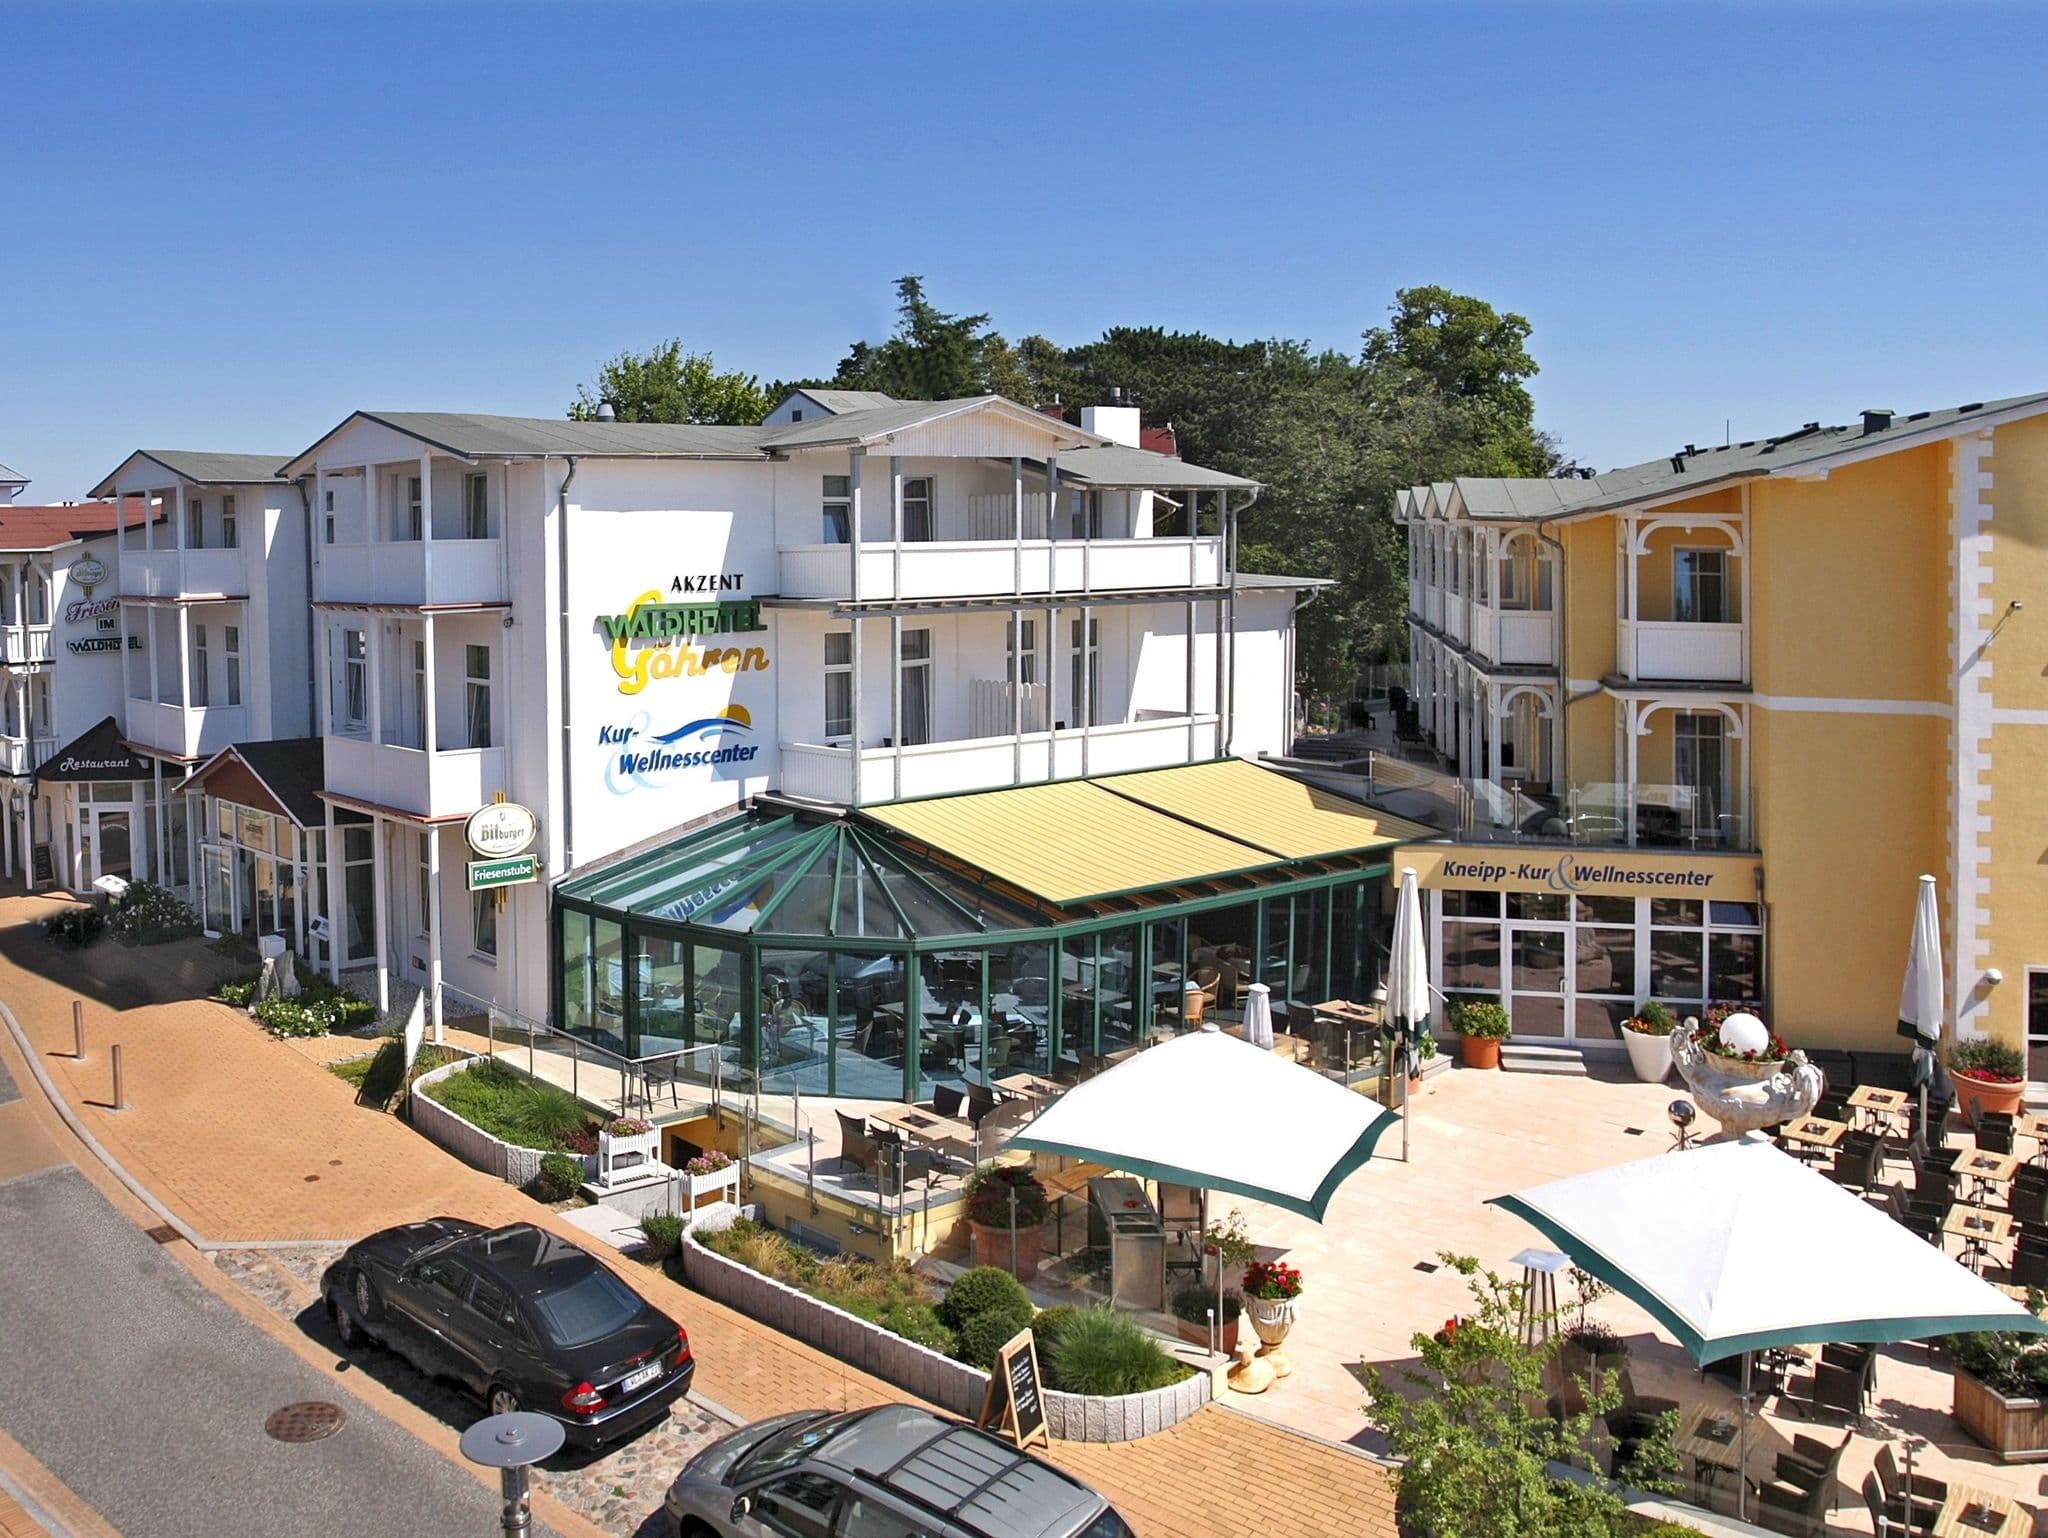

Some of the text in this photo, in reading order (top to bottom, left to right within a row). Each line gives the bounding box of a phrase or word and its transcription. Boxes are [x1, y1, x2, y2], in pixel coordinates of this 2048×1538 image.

[671, 574, 743, 591] AKZENT
[65, 599, 120, 623] Friesen
[597, 601, 768, 638] WALDHOTEL
[99, 619, 115, 629] IM
[69, 636, 143, 653] WALDHOEL
[599, 725, 639, 745] Kur-
[60, 757, 129, 772] Restaurant
[619, 744, 758, 775] Wellnesscenter
[474, 863, 532, 881] Friesenstube
[1574, 866, 1714, 886] Wellnesscenter
